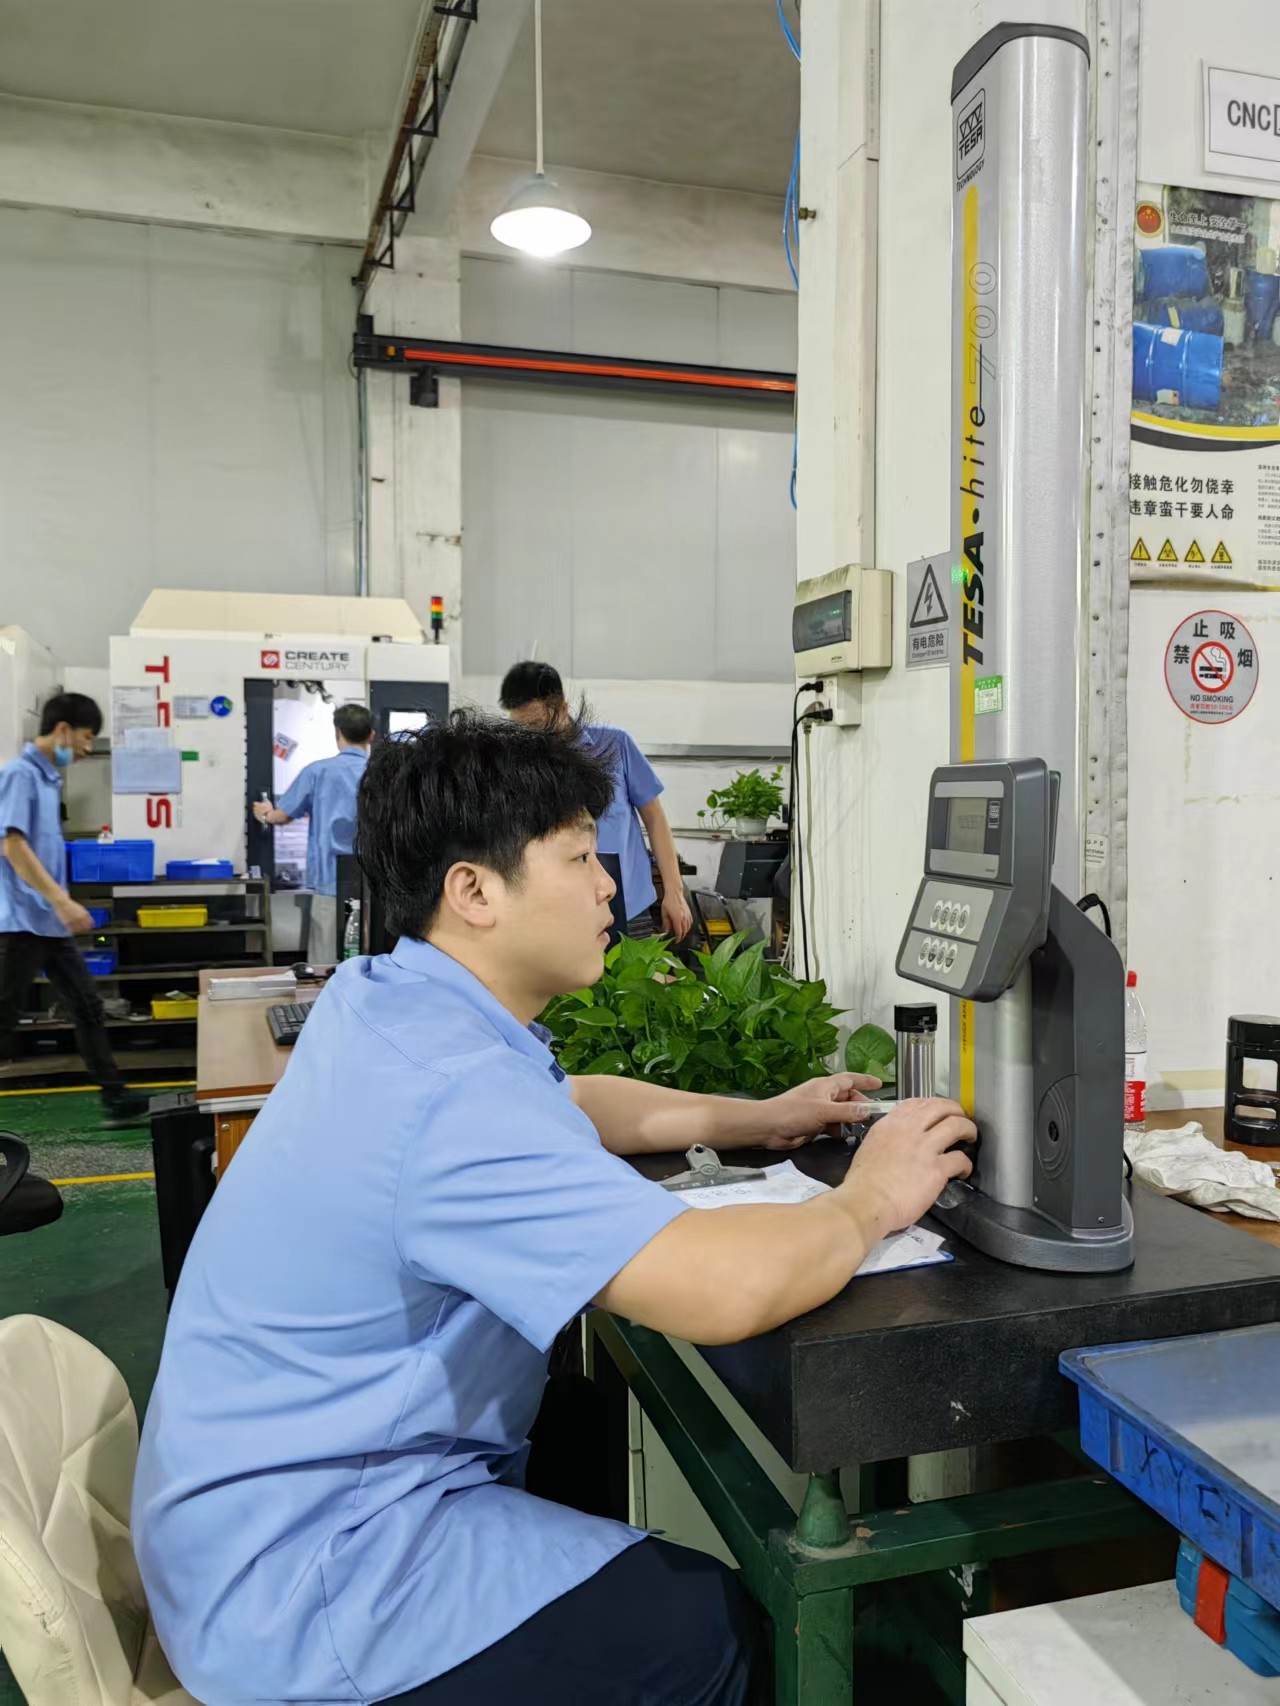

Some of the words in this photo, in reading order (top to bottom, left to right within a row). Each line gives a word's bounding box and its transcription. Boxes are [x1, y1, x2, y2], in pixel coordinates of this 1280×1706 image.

[959, 124, 983, 161] TESA
[968, 261, 998, 386] 700
[1129, 473, 1235, 496] 接触危化勿侥幸
[1129, 499, 1235, 521] 违章蛮干要人命
[963, 532, 984, 666] TESA
[912, 632, 945, 651] 有电危险
[285, 651, 350, 662] CREATE
[285, 661, 350, 671] CENTURY
[1190, 694, 1201, 702] NO
[1202, 694, 1234, 703] SMOKING
